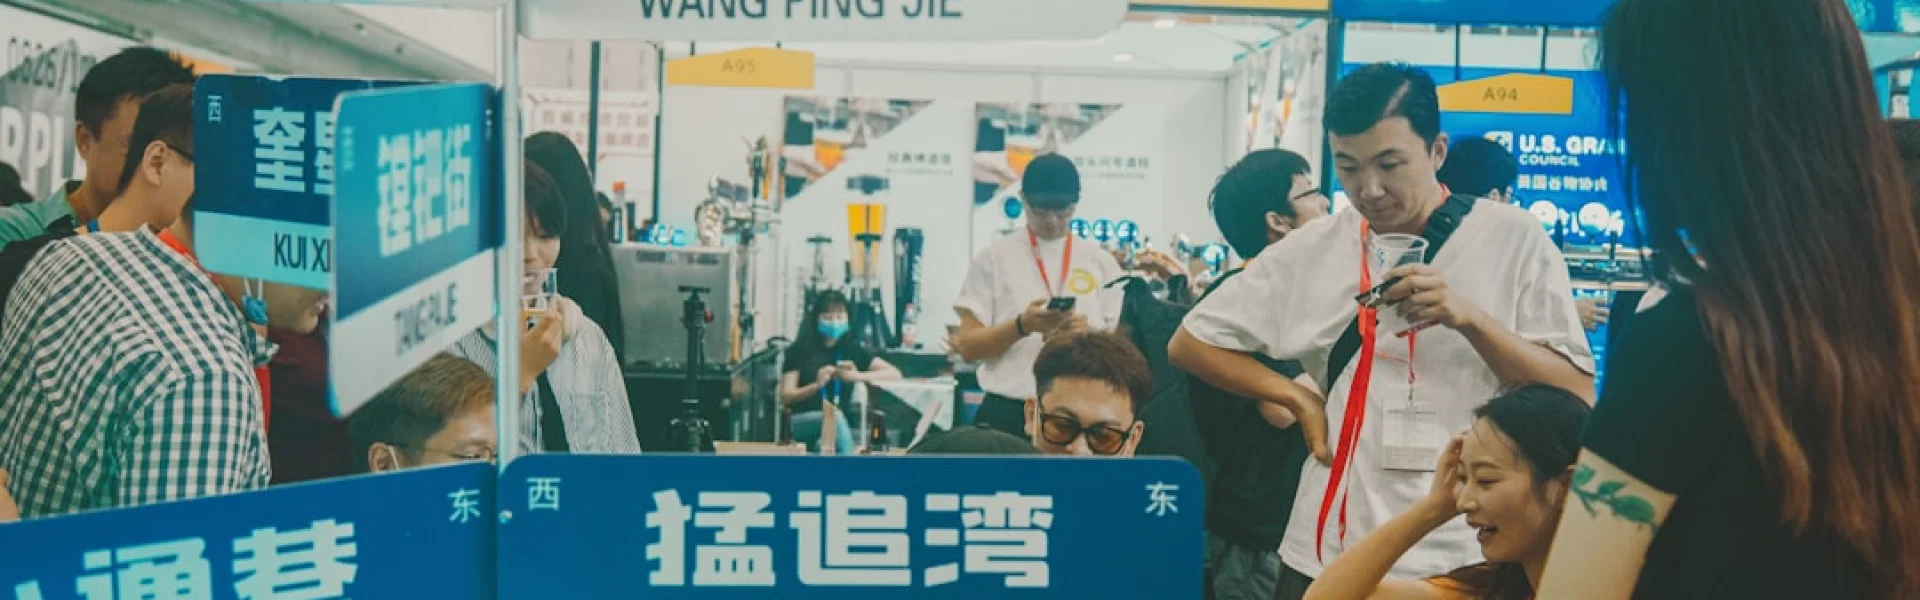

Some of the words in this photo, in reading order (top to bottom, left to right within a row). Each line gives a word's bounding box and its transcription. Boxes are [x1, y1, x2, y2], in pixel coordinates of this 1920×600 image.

[640, 0, 767, 19] WANG
[902, 0, 963, 19] JIE
[721, 59, 757, 74] A95
[1483, 86, 1518, 101] A94
[207, 95, 223, 123] 西
[1519, 134, 1562, 154] U.S.
[1519, 154, 1580, 167] COUNCIL
[274, 232, 308, 271] KUI
[448, 488, 482, 523] 东
[526, 477, 561, 511] 西
[1144, 481, 1180, 517] 东
[645, 488, 1055, 588] 猛追湾
